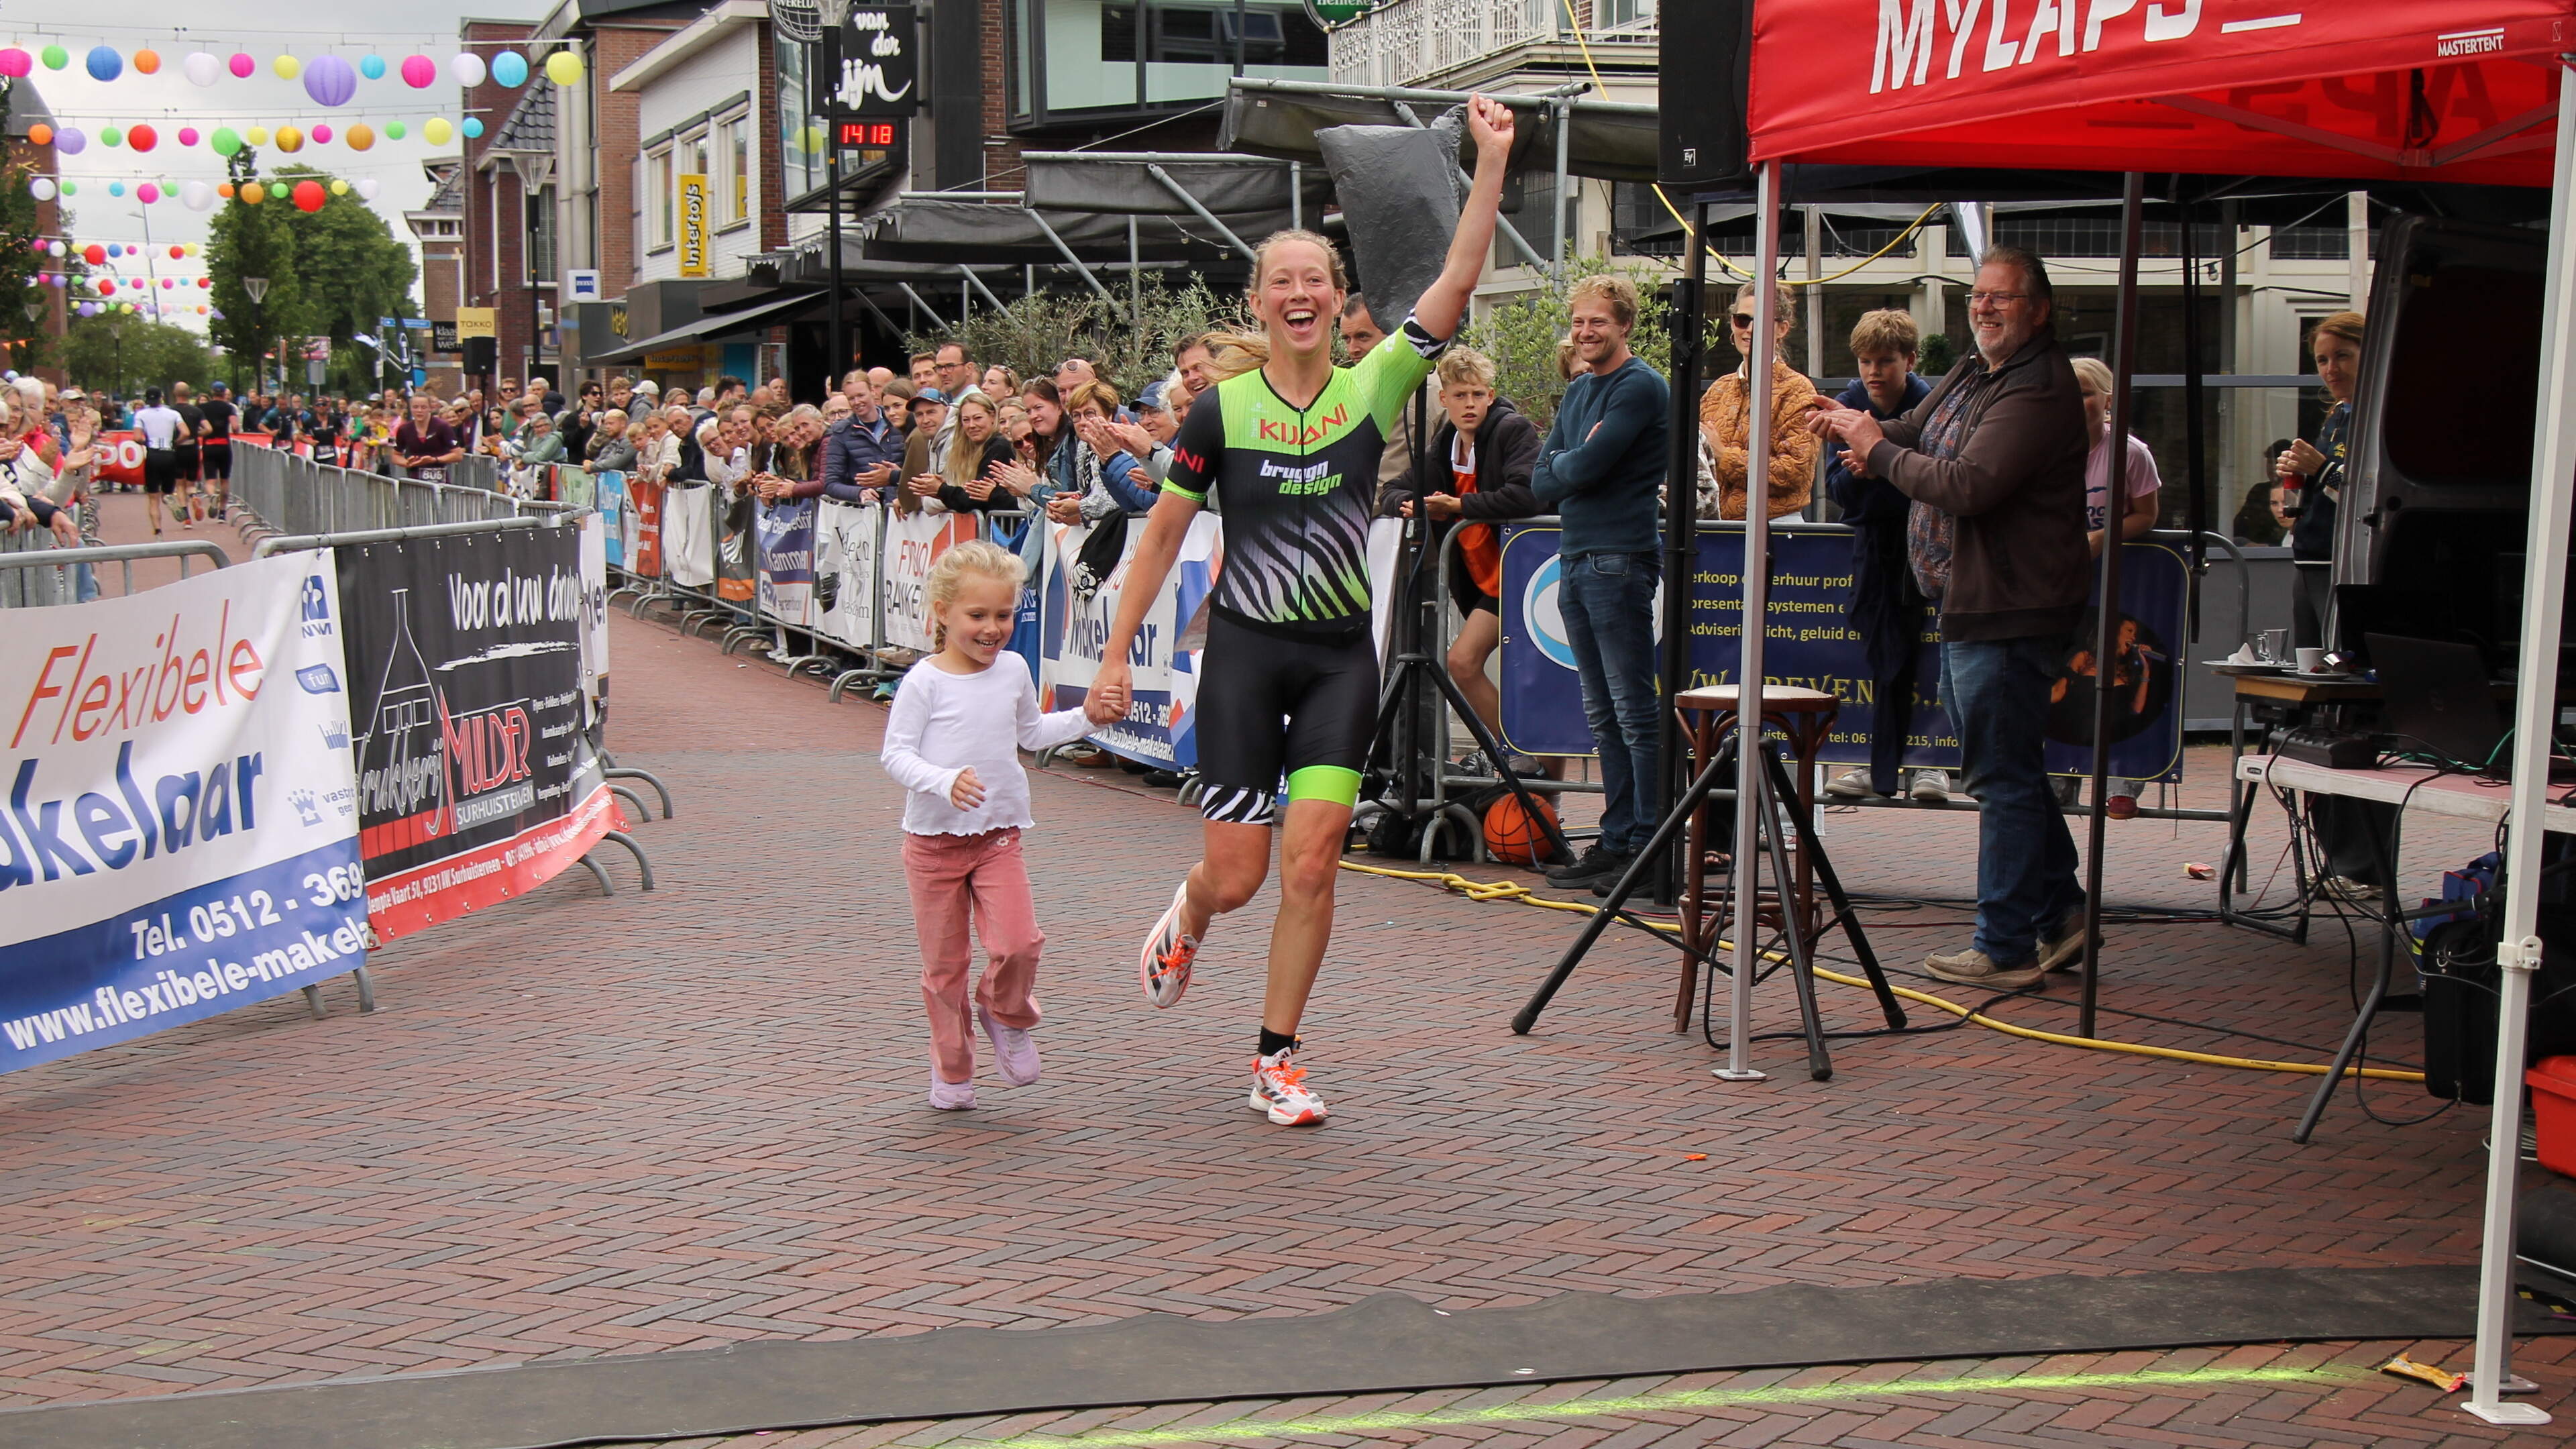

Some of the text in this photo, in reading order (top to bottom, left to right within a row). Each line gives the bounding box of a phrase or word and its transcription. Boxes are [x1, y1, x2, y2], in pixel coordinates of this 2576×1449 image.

[854, 12, 890, 31] van
[871, 30, 901, 56] der
[2437, 34, 2504, 57] MASTERTENT
[824, 58, 912, 111] ijn
[684, 184, 703, 267] Intertoys
[1259, 403, 1348, 445] KIJANI
[1279, 473, 1342, 496] design
[449, 572, 490, 631] Voor
[515, 574, 543, 626] uw
[1767, 600, 1834, 614] systemen
[1800, 627, 1844, 641] geluid
[10, 599, 264, 749] Flexibele
[1829, 733, 1849, 743] tel:
[1851, 733, 1866, 744] 06
[439, 684, 531, 835] MULDER
[131, 912, 188, 960] Tel.
[189, 890, 282, 943] 0512
